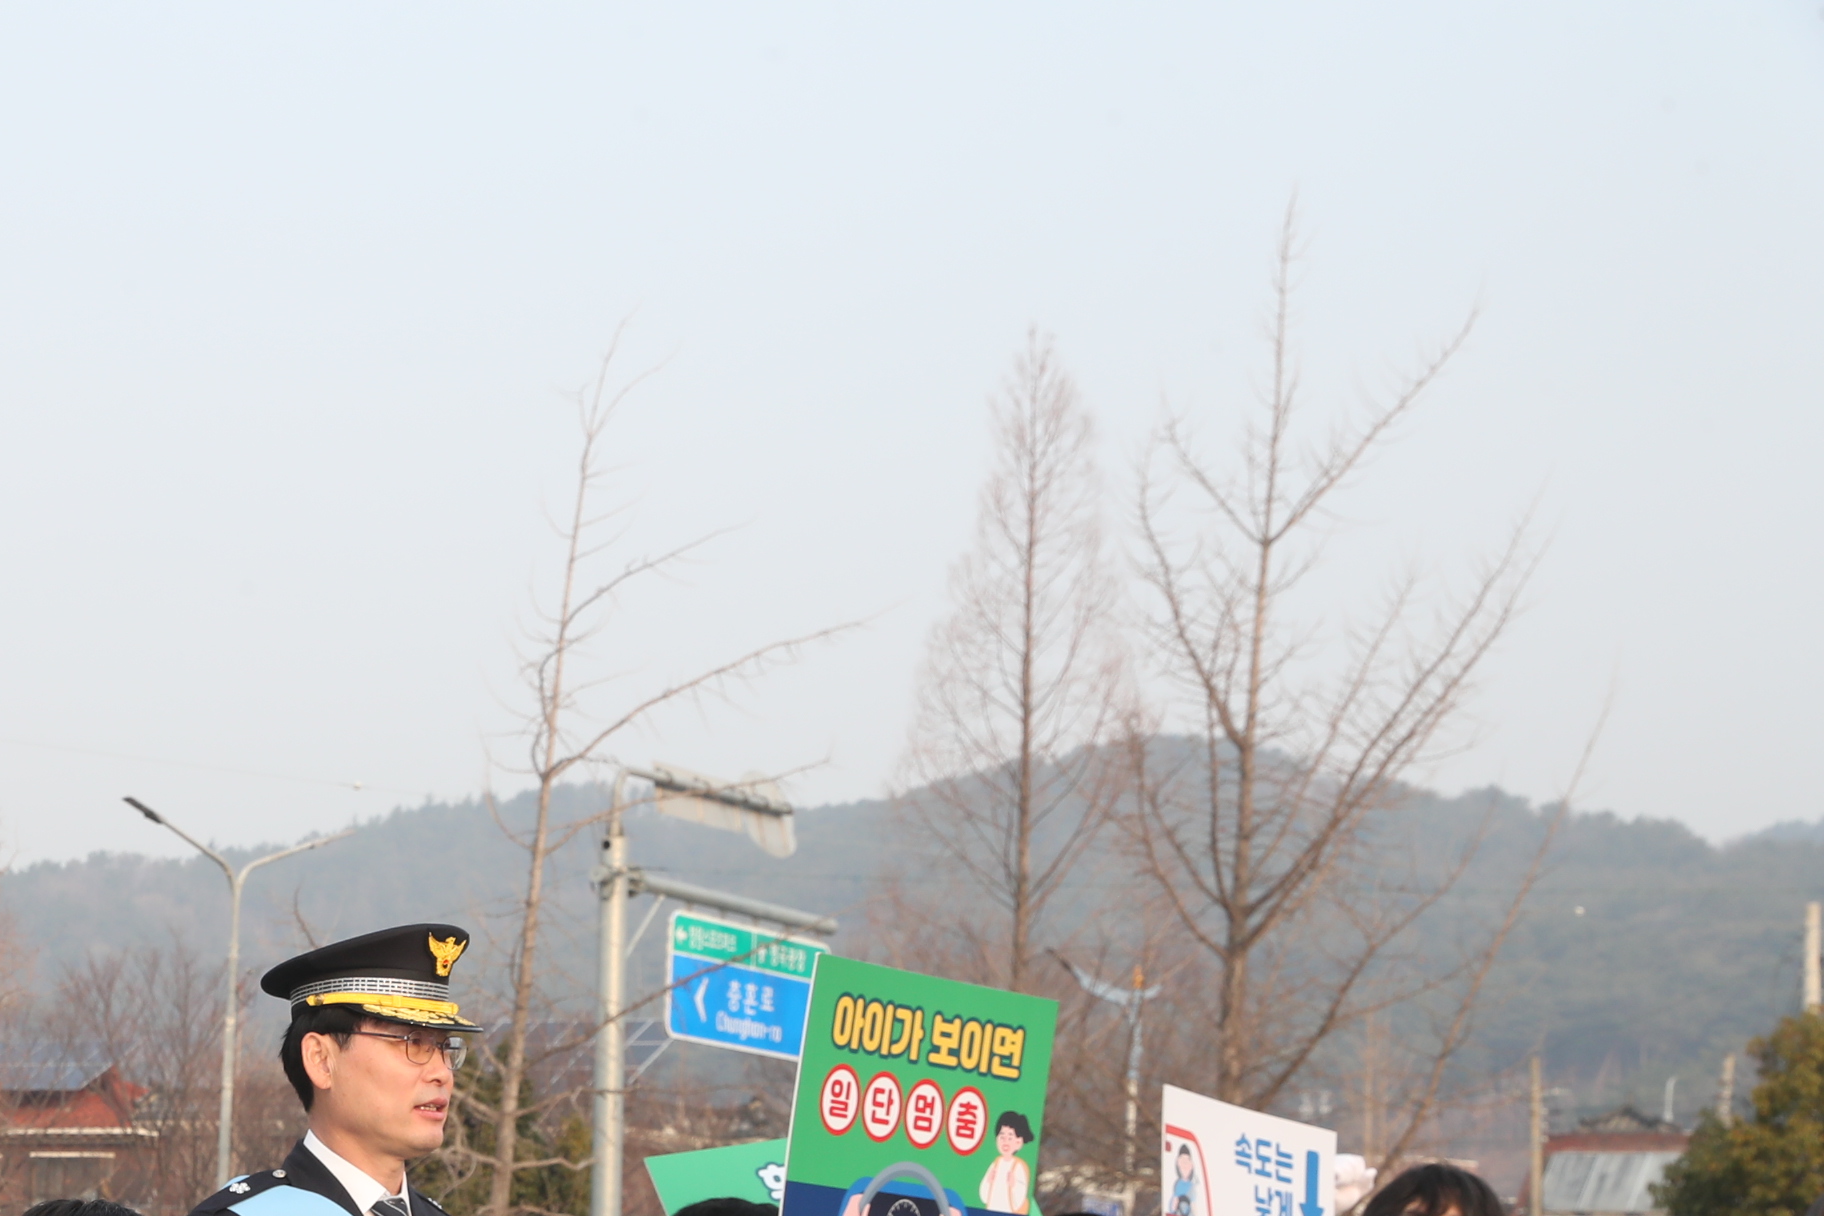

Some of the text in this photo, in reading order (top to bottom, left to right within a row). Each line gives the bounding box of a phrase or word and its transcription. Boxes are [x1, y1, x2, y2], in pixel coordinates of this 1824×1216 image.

[832, 994, 1026, 1080] 아이가 보이면
[1234, 1133, 1294, 1184] 속도는
